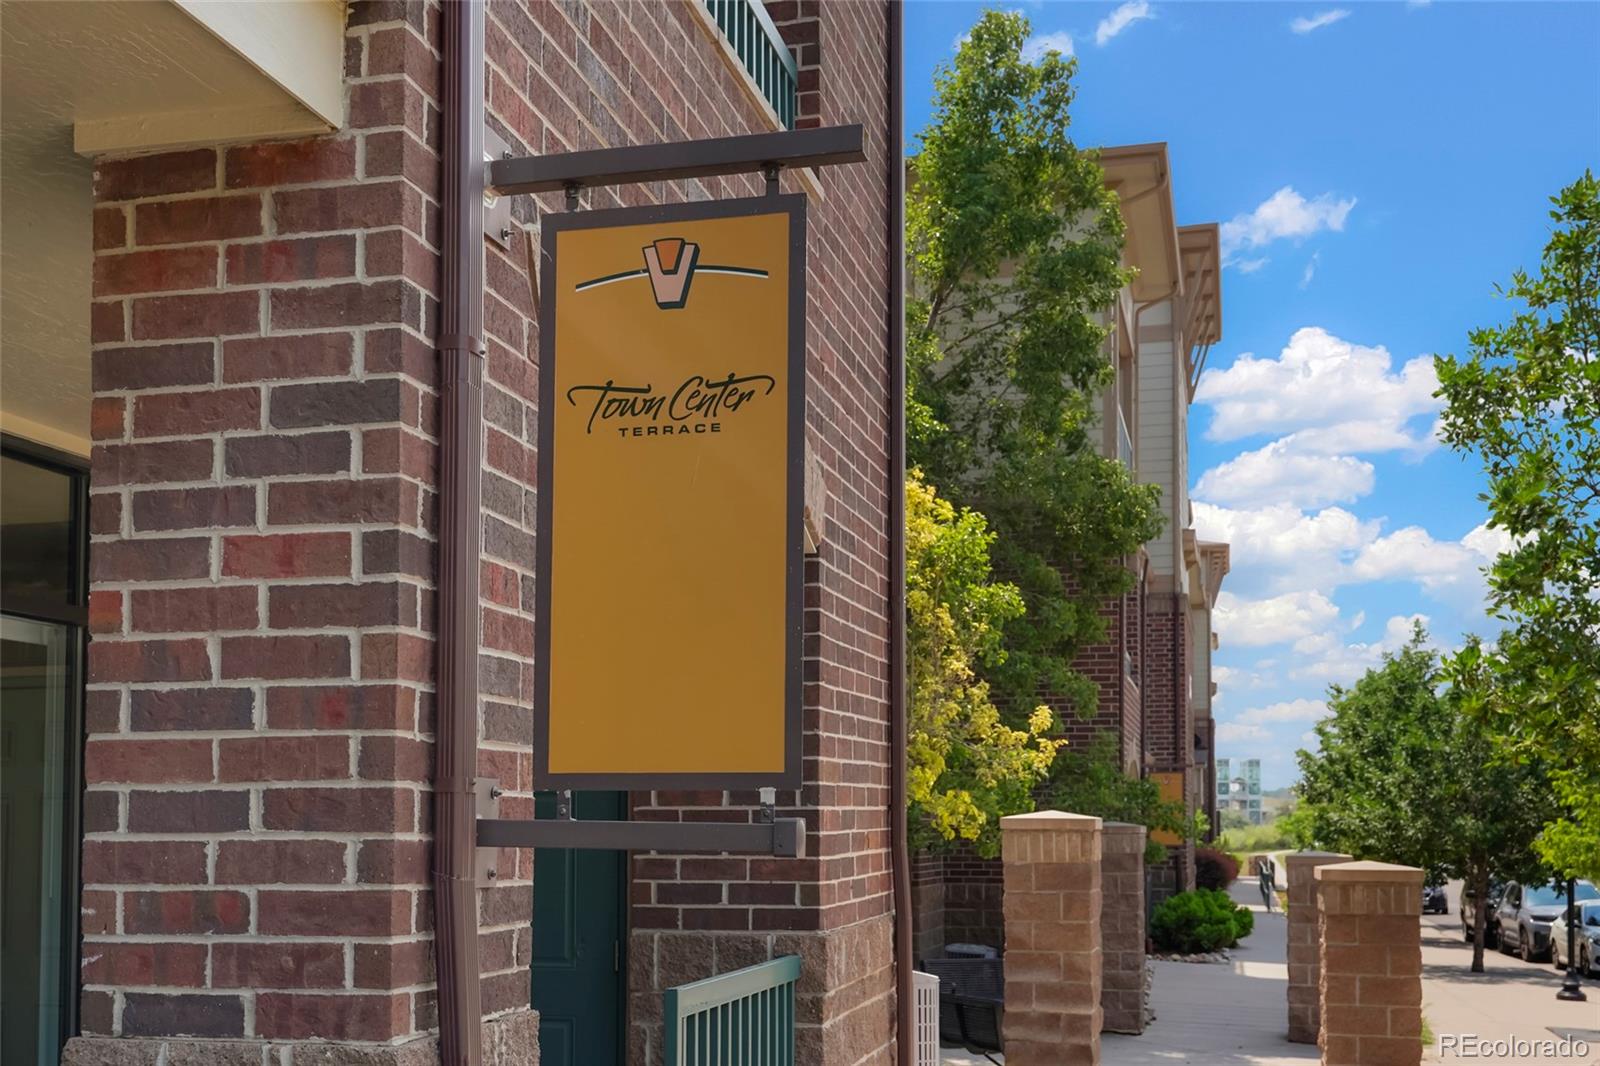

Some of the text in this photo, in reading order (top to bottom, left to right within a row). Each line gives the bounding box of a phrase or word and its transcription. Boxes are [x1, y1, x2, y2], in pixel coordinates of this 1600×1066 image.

[567, 372, 775, 434] Town Center
[619, 422, 721, 437] TERRACE
